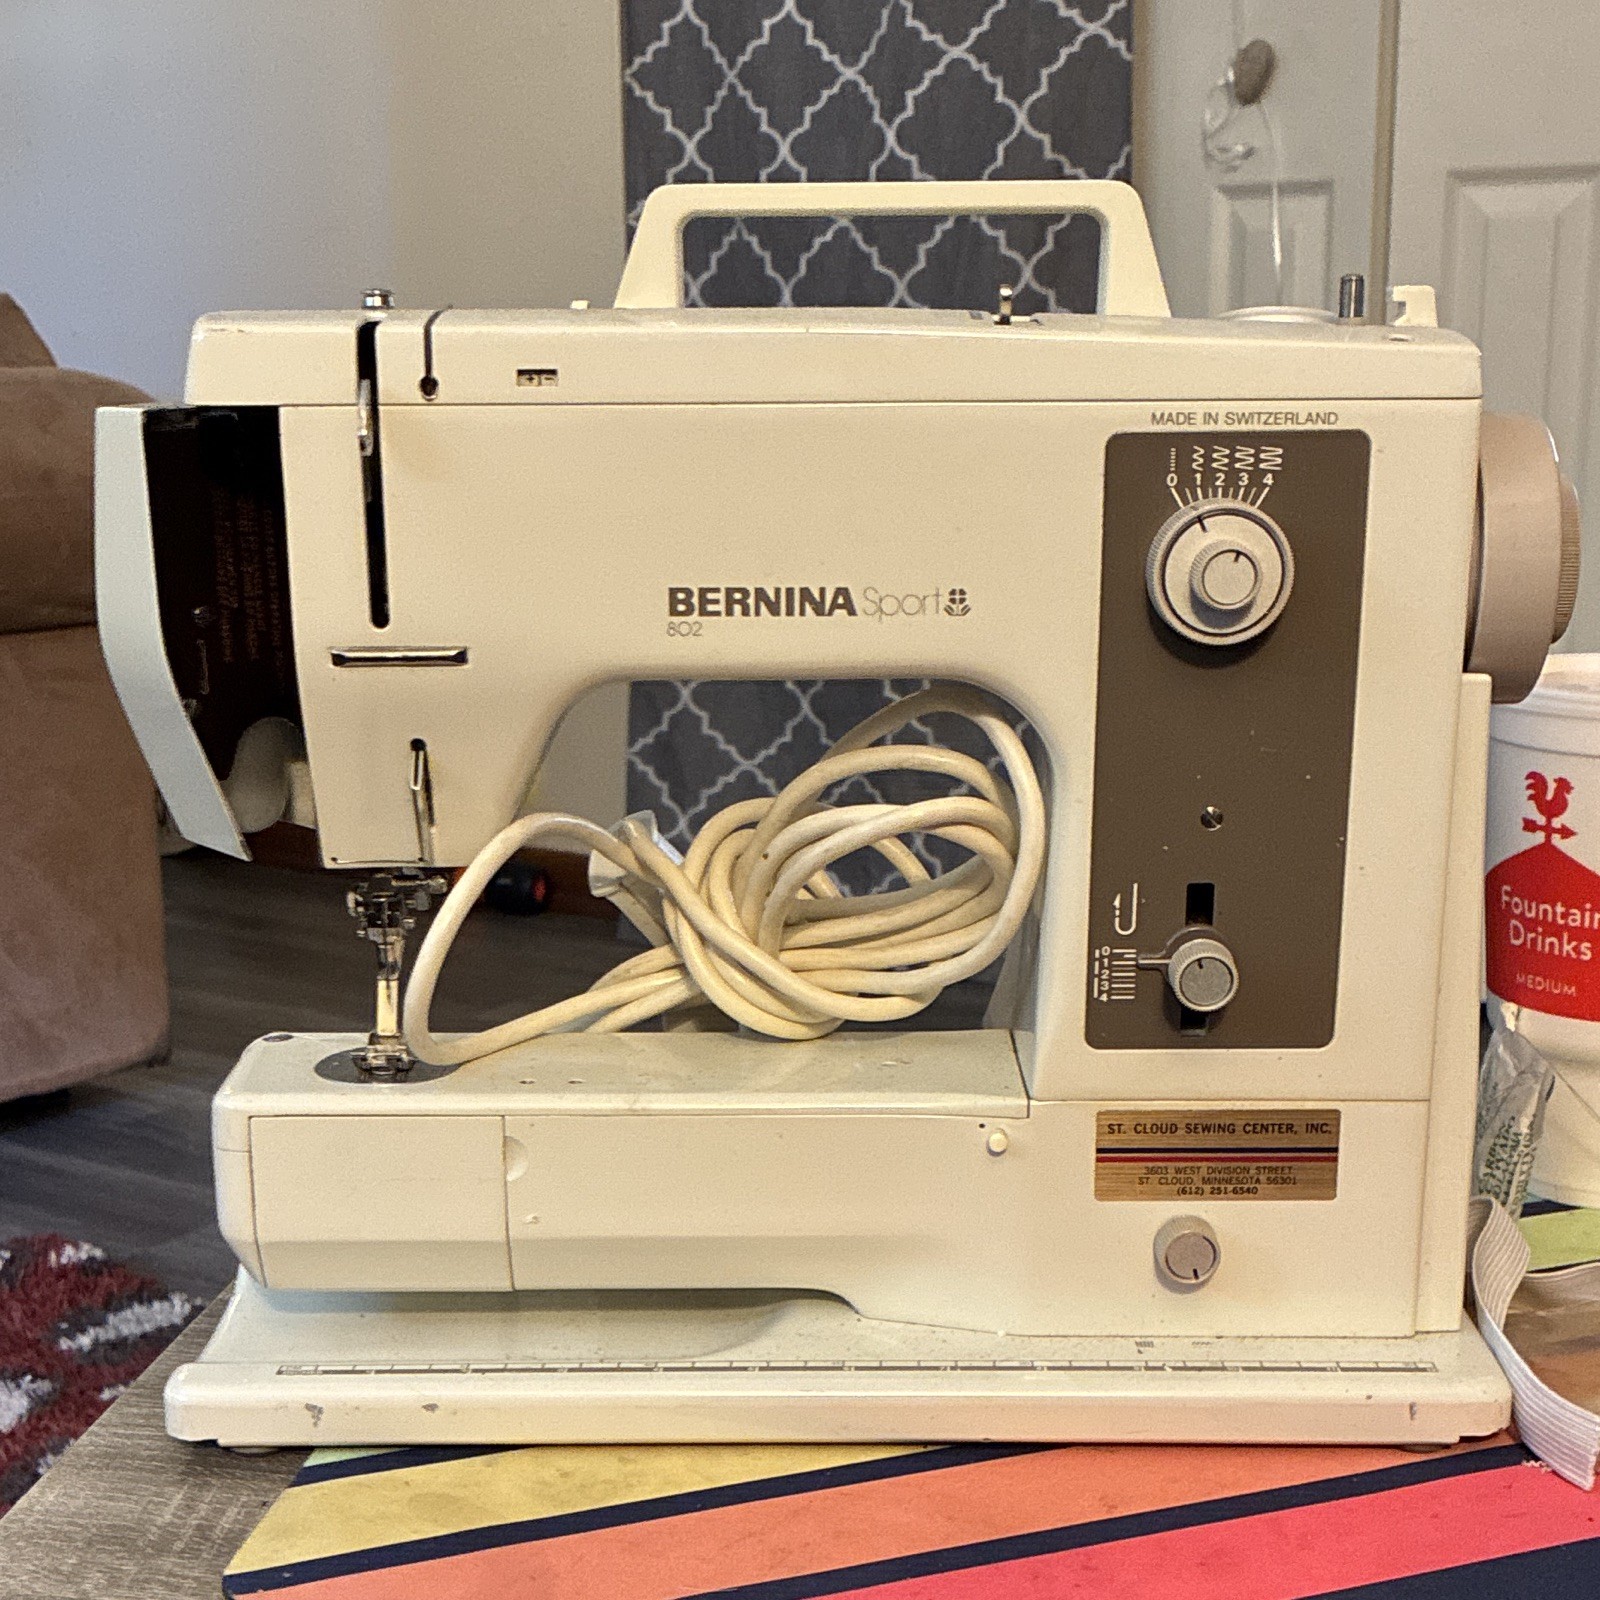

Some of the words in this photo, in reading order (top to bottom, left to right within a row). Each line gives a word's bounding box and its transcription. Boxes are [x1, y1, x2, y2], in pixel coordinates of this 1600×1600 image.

[1151, 412, 1197, 425] MADE
[1203, 412, 1219, 425] IN
[1224, 411, 1338, 425] SWITZERLAND
[1166, 473, 1178, 486] 0
[1194, 473, 1202, 486] 1
[1214, 473, 1225, 486] 2
[1238, 472, 1249, 486] 3
[1263, 472, 1274, 486] 4
[668, 587, 858, 617] BERNINA
[862, 586, 943, 623] Sport
[666, 621, 703, 637] 802
[1509, 919, 1592, 961] Drinks
[1101, 946, 1111, 956] 0
[1100, 969, 1110, 979] 2
[1100, 981, 1110, 990] 3
[1516, 972, 1576, 997] MEDIUM
[1107, 1123, 1126, 1134] ST.
[1134, 1123, 1178, 1134] CLOUD
[1185, 1123, 1236, 1134] SEWING
[1243, 1123, 1298, 1135] CENTER,
[1305, 1123, 1332, 1134] INC.
[1174, 1166, 1201, 1175] WEST
[1207, 1166, 1250, 1175] DIVISION
[1255, 1166, 1293, 1175] STREET
[1202, 1176, 1261, 1185] MINNESOTA
[1266, 1176, 1297, 1185] 56301
[1177, 1186, 1204, 1196] (612)
[1209, 1186, 1259, 1195] 251-6540
